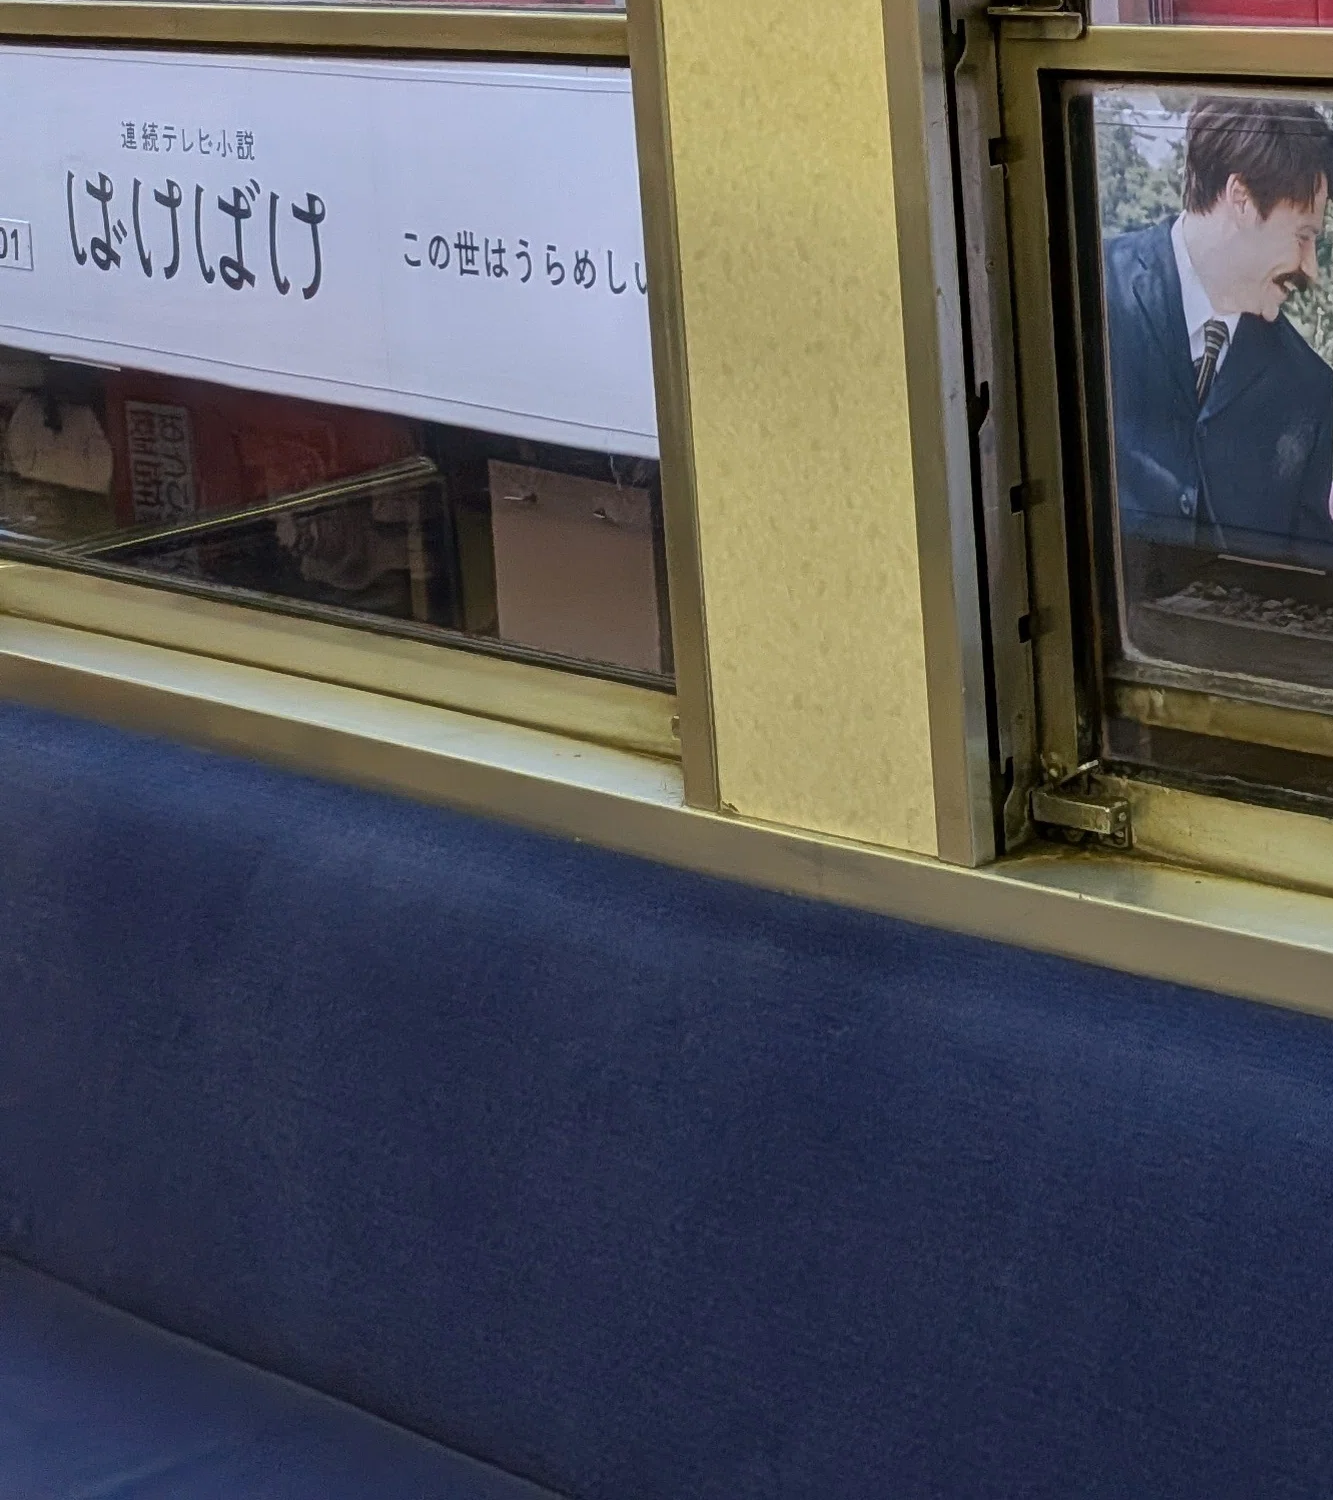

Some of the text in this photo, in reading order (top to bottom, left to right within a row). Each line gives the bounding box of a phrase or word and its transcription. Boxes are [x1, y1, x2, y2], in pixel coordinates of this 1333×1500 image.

[121, 120, 256, 161] 連続テレビ小説
[66, 170, 326, 300] ばけばけ
